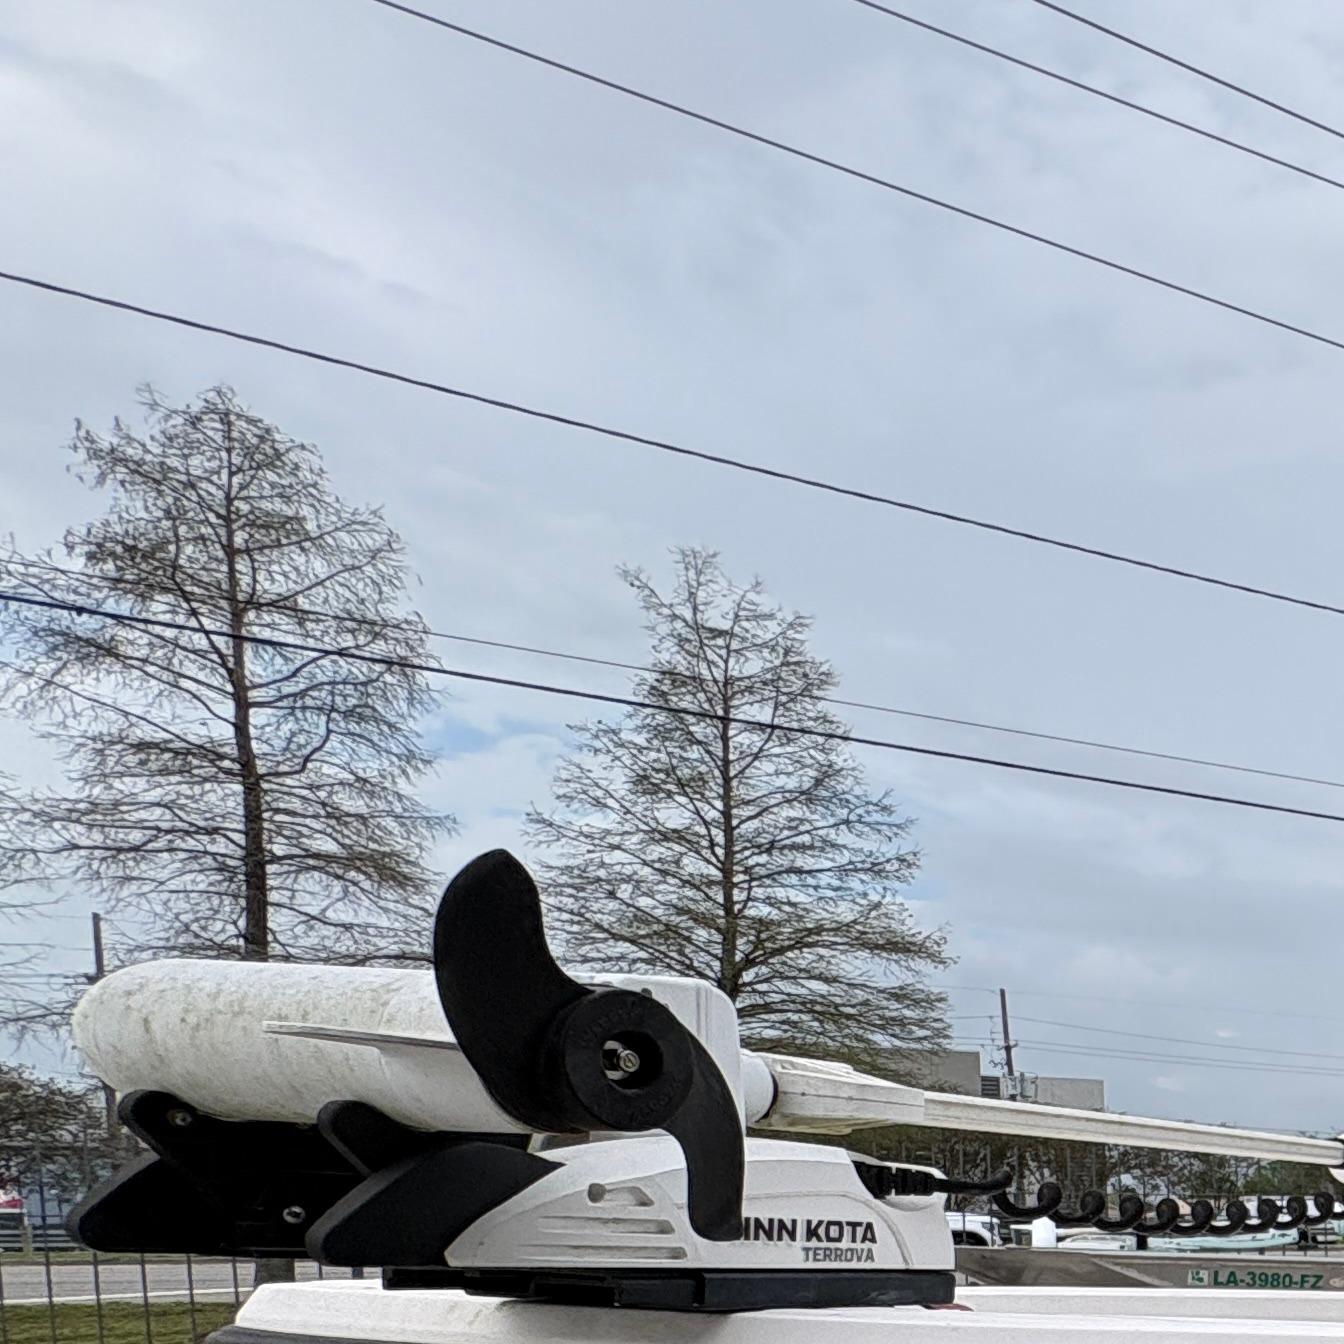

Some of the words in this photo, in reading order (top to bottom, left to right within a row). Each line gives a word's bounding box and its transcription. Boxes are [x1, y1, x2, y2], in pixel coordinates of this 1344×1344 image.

[743, 1217, 798, 1242] INN
[804, 1219, 878, 1245] KOTA
[801, 1247, 876, 1263] TERROVA
[1212, 1270, 1324, 1289] LA-3980-FZ
